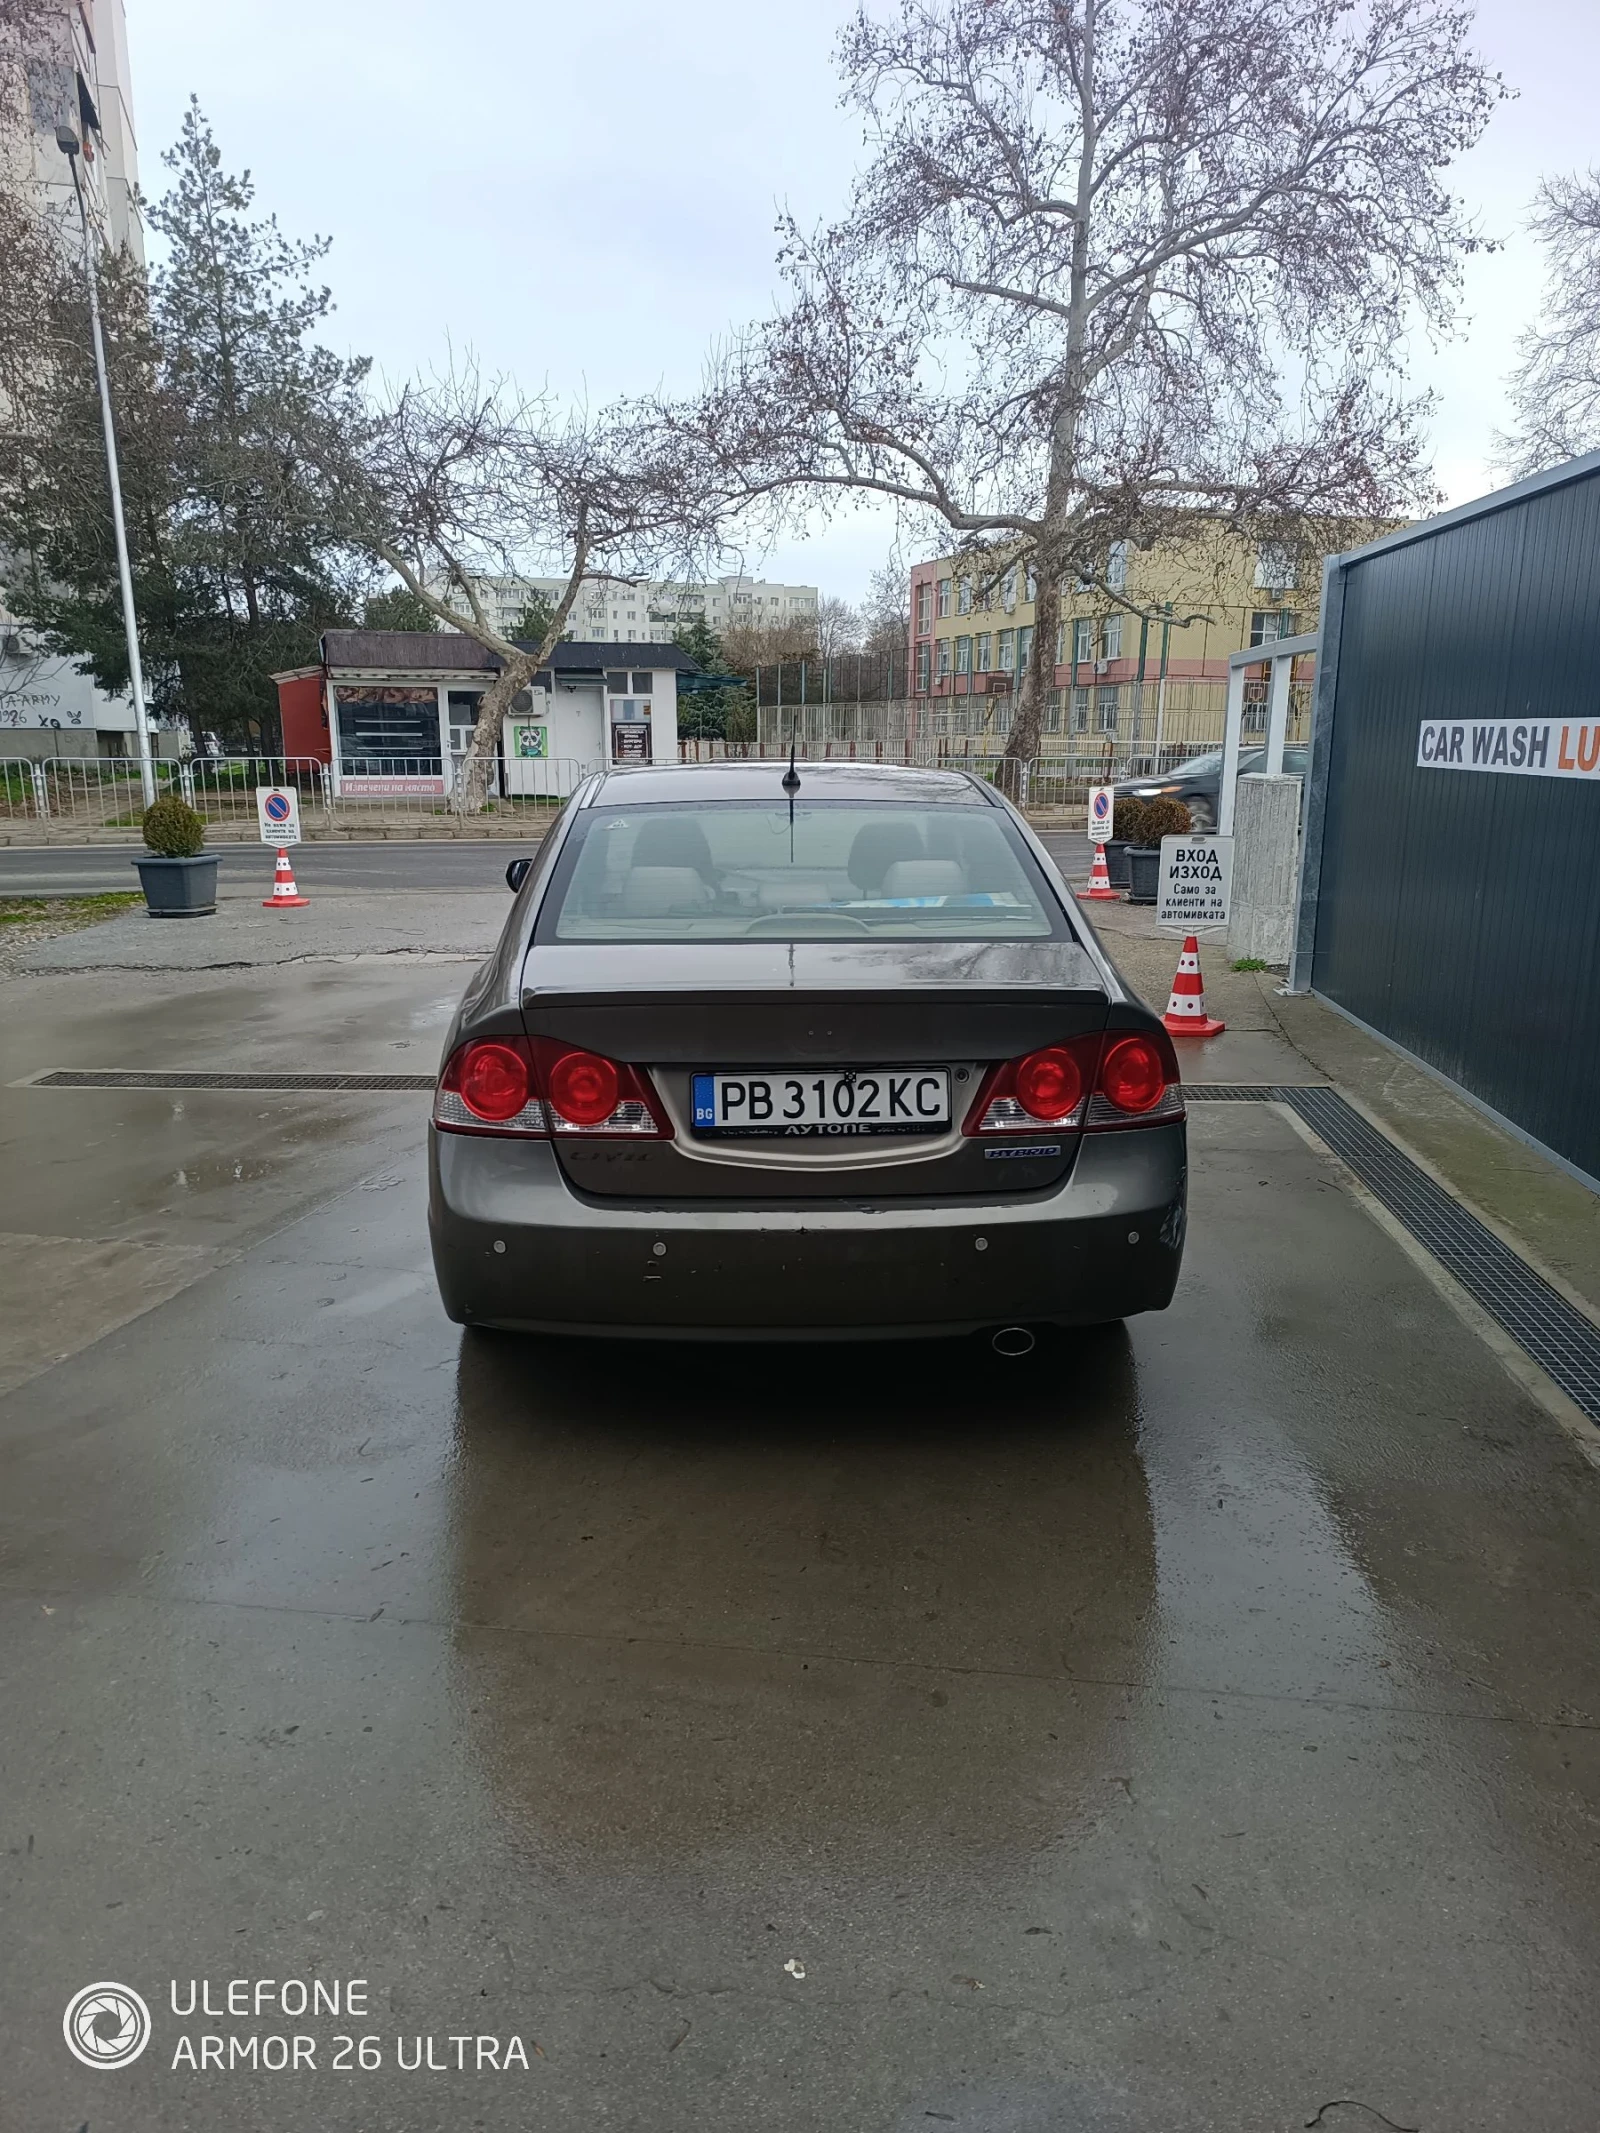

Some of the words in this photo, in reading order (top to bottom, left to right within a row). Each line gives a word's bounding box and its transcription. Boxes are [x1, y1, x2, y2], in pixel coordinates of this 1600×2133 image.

[1421, 725, 1464, 763] CAR
[1472, 725, 1550, 768] WASH
[1558, 725, 1600, 771] LU
[345, 782, 390, 792] Изпечени
[391, 784, 403, 792] на
[1175, 849, 1219, 864] ВХОД
[1169, 866, 1222, 881] ИЗХОД
[1173, 883, 1200, 895] Само
[1204, 886, 1216, 895] за
[1165, 898, 1205, 907] клиенти
[1210, 898, 1222, 907] на
[1161, 910, 1226, 919] автомивката
[696, 1108, 713, 1120] BG
[989, 1147, 1058, 1158] HYBRID
